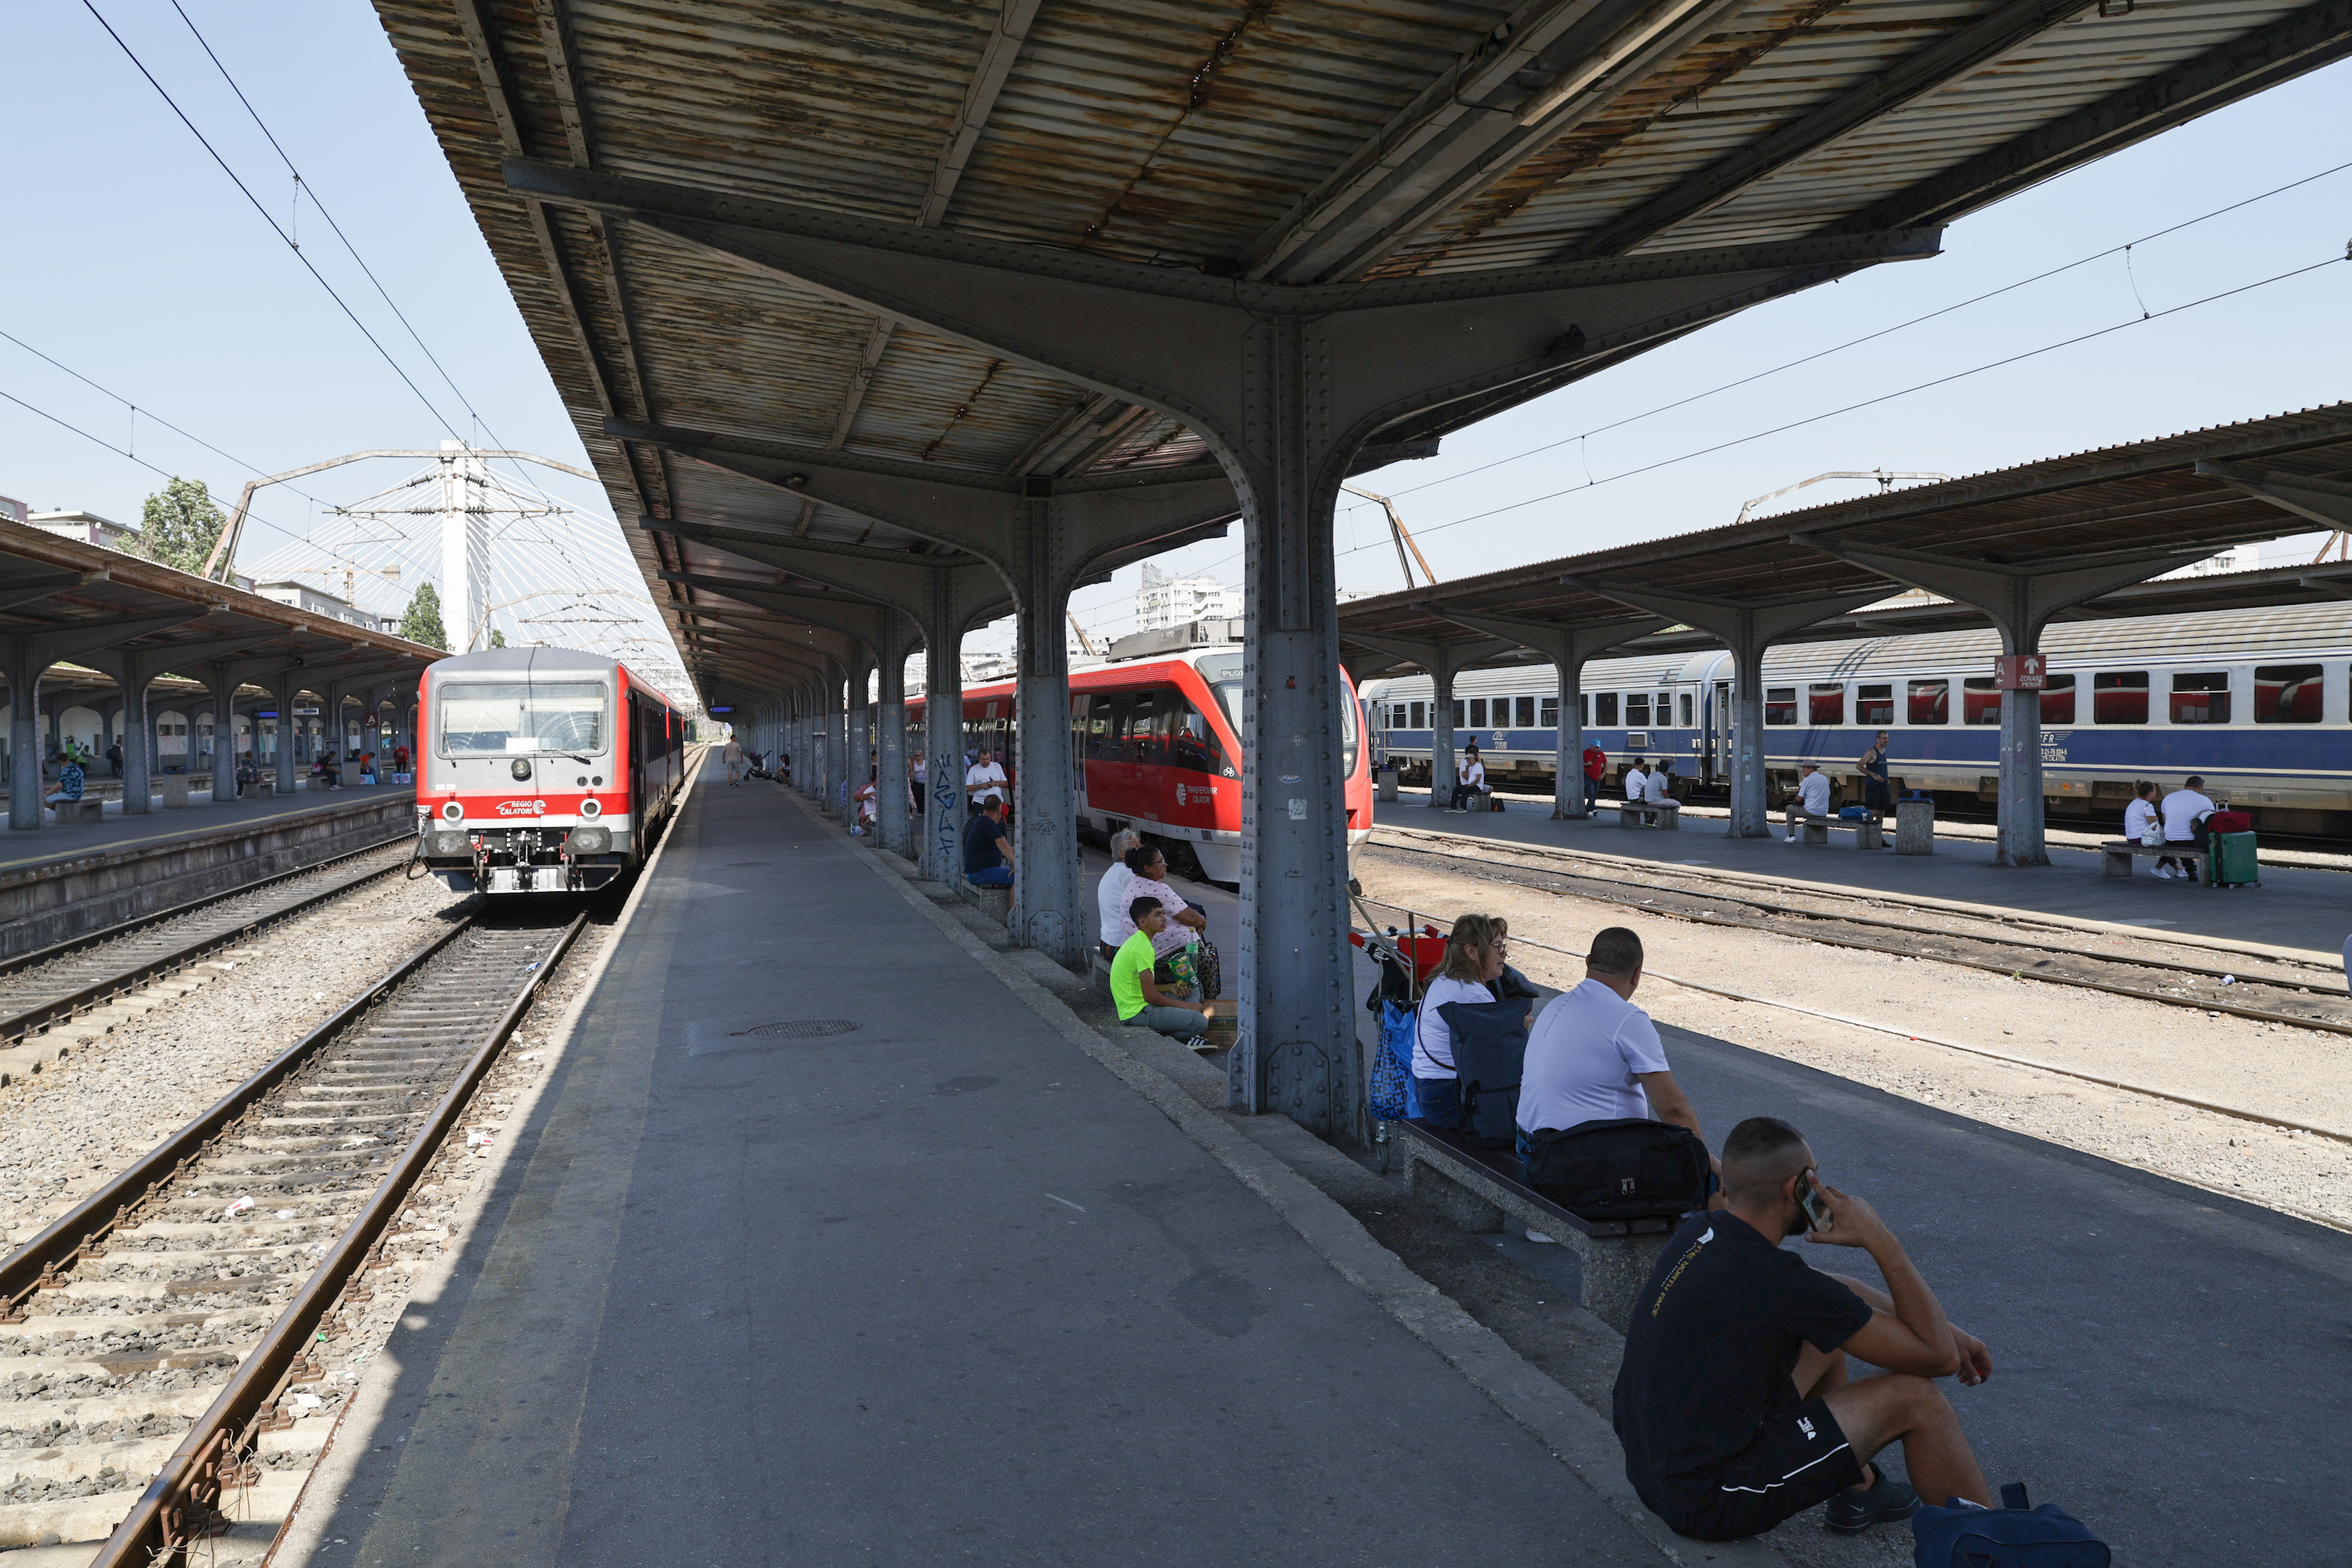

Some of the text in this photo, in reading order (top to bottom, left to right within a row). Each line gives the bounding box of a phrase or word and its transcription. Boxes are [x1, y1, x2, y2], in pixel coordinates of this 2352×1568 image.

[1996, 661, 2005, 675] A
[368, 715, 376, 724] A
[1686, 1245, 1702, 1259] THE
[1664, 1261, 1689, 1291] NORTH
[1652, 1292, 1666, 1317] FACE
